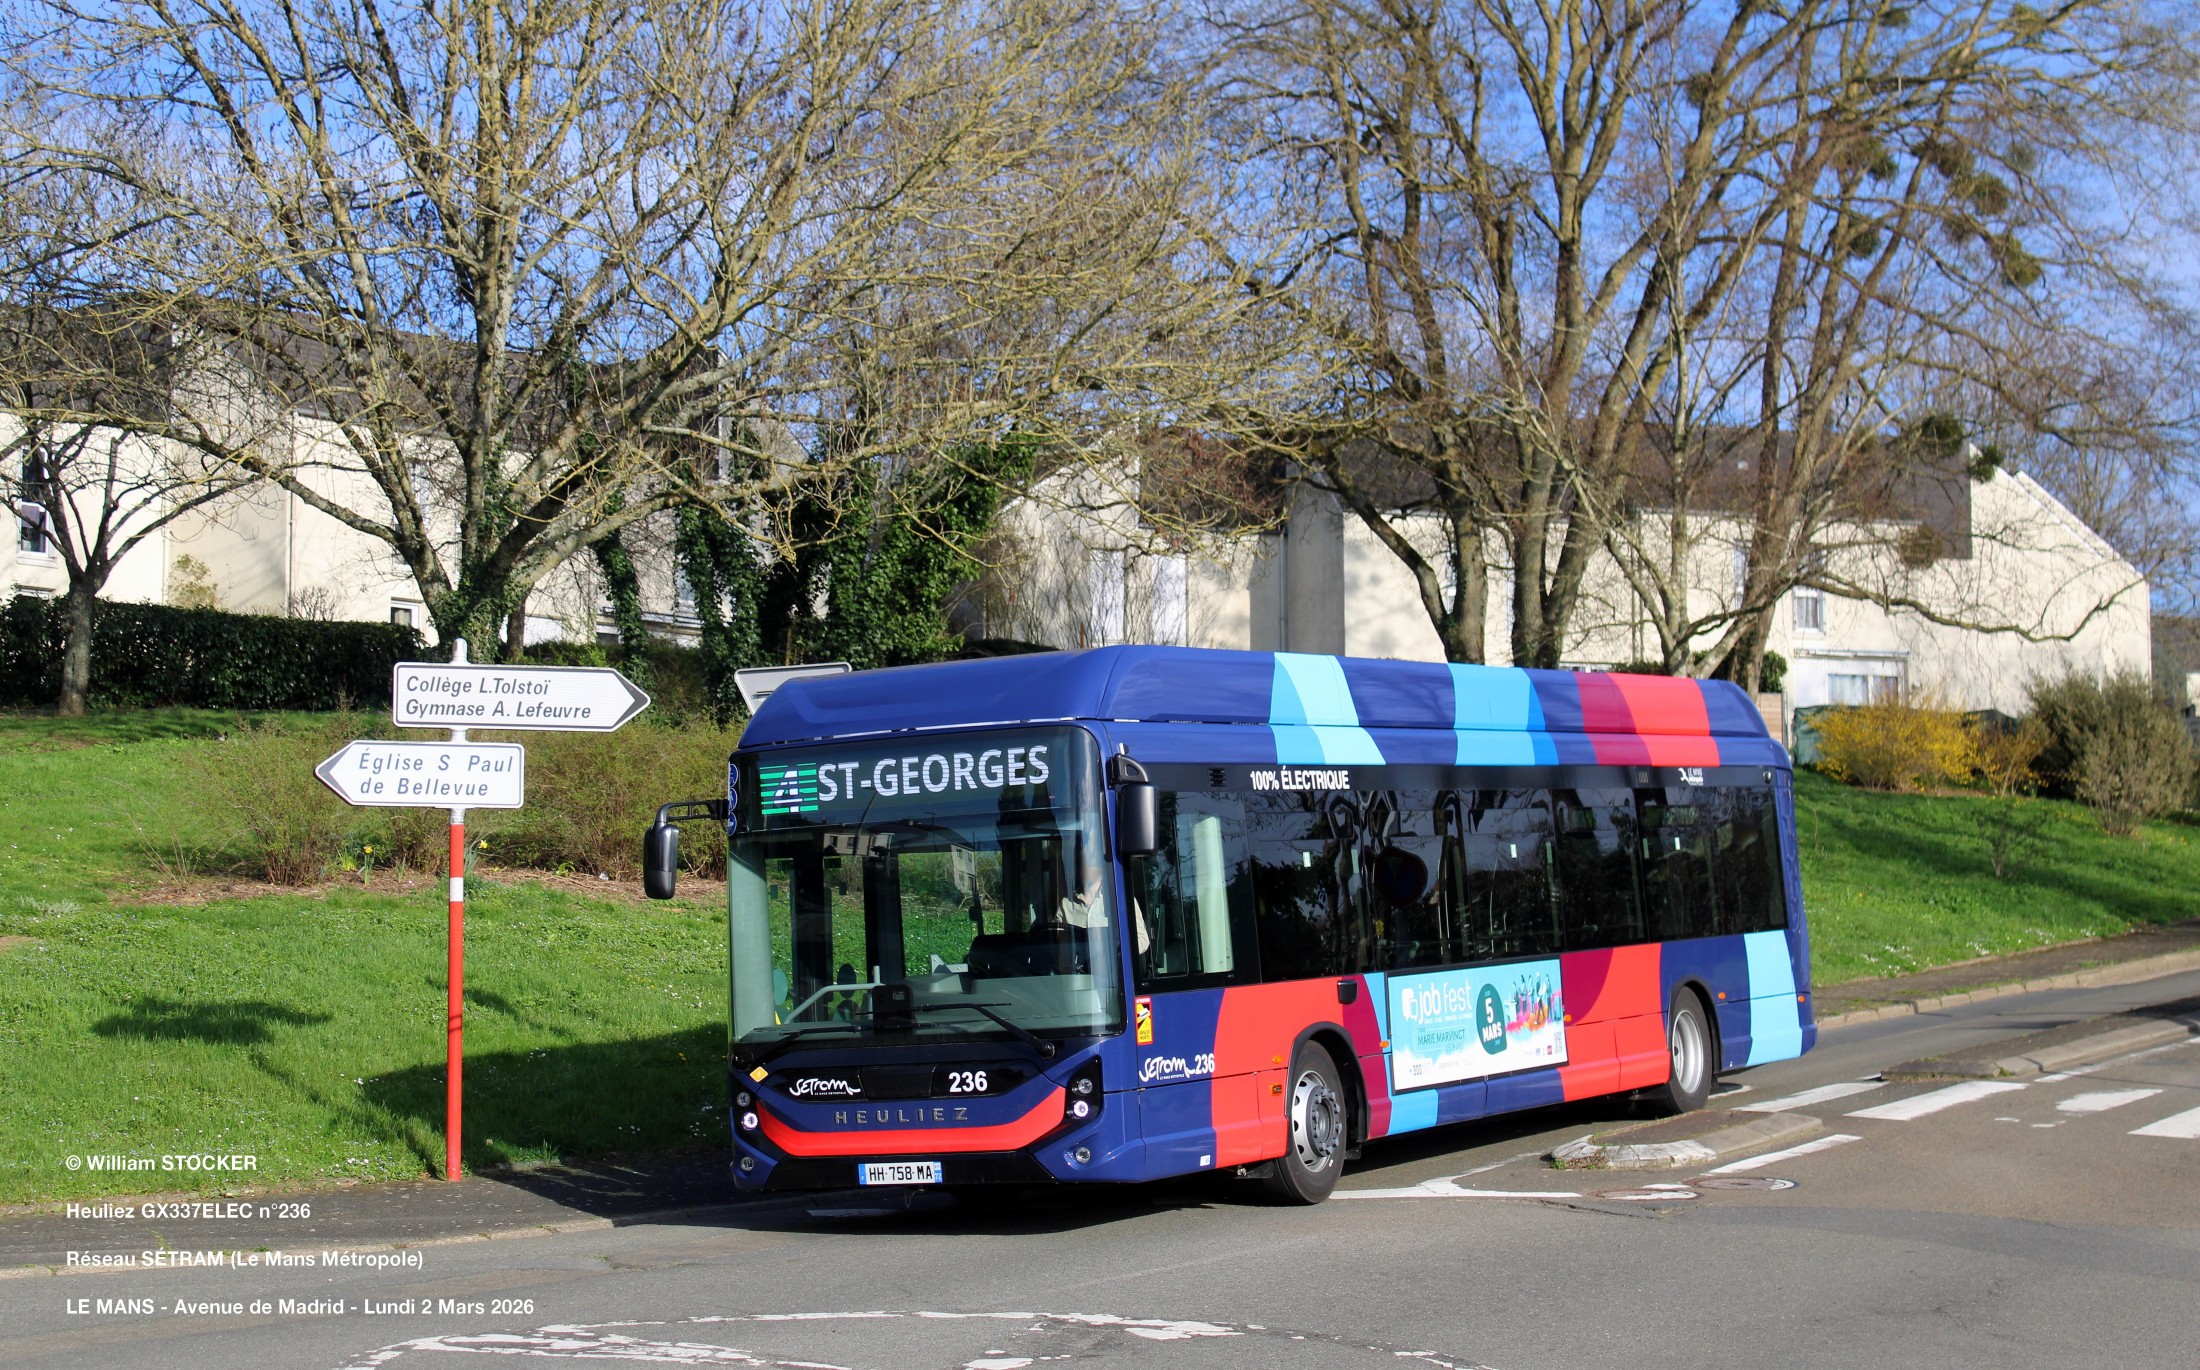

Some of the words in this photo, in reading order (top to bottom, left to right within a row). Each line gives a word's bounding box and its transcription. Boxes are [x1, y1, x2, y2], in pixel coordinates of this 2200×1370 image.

[407, 675, 472, 698] Collège
[479, 677, 551, 695] L.Tolstoï
[406, 699, 485, 718] Gymnase
[492, 700, 510, 717] A.
[516, 701, 592, 719] Lefeuvre
[359, 747, 424, 775] Église
[467, 755, 513, 773] Paul
[817, 745, 1050, 802] ST-GEORGES
[1249, 770, 1280, 791] 100%
[1280, 765, 1350, 790] ÉLECTRIQUE
[360, 777, 384, 795] de
[397, 777, 489, 796] Bellevue
[1418, 982, 1442, 1026] job
[1443, 979, 1473, 1014] fest
[1485, 997, 1494, 1024] 5
[1417, 1032, 1436, 1046] MARIE
[1482, 1021, 1503, 1043] MARS
[1195, 1053, 1215, 1075] 236
[949, 1070, 988, 1093] 236
[834, 1107, 968, 1124] HEULIEZ
